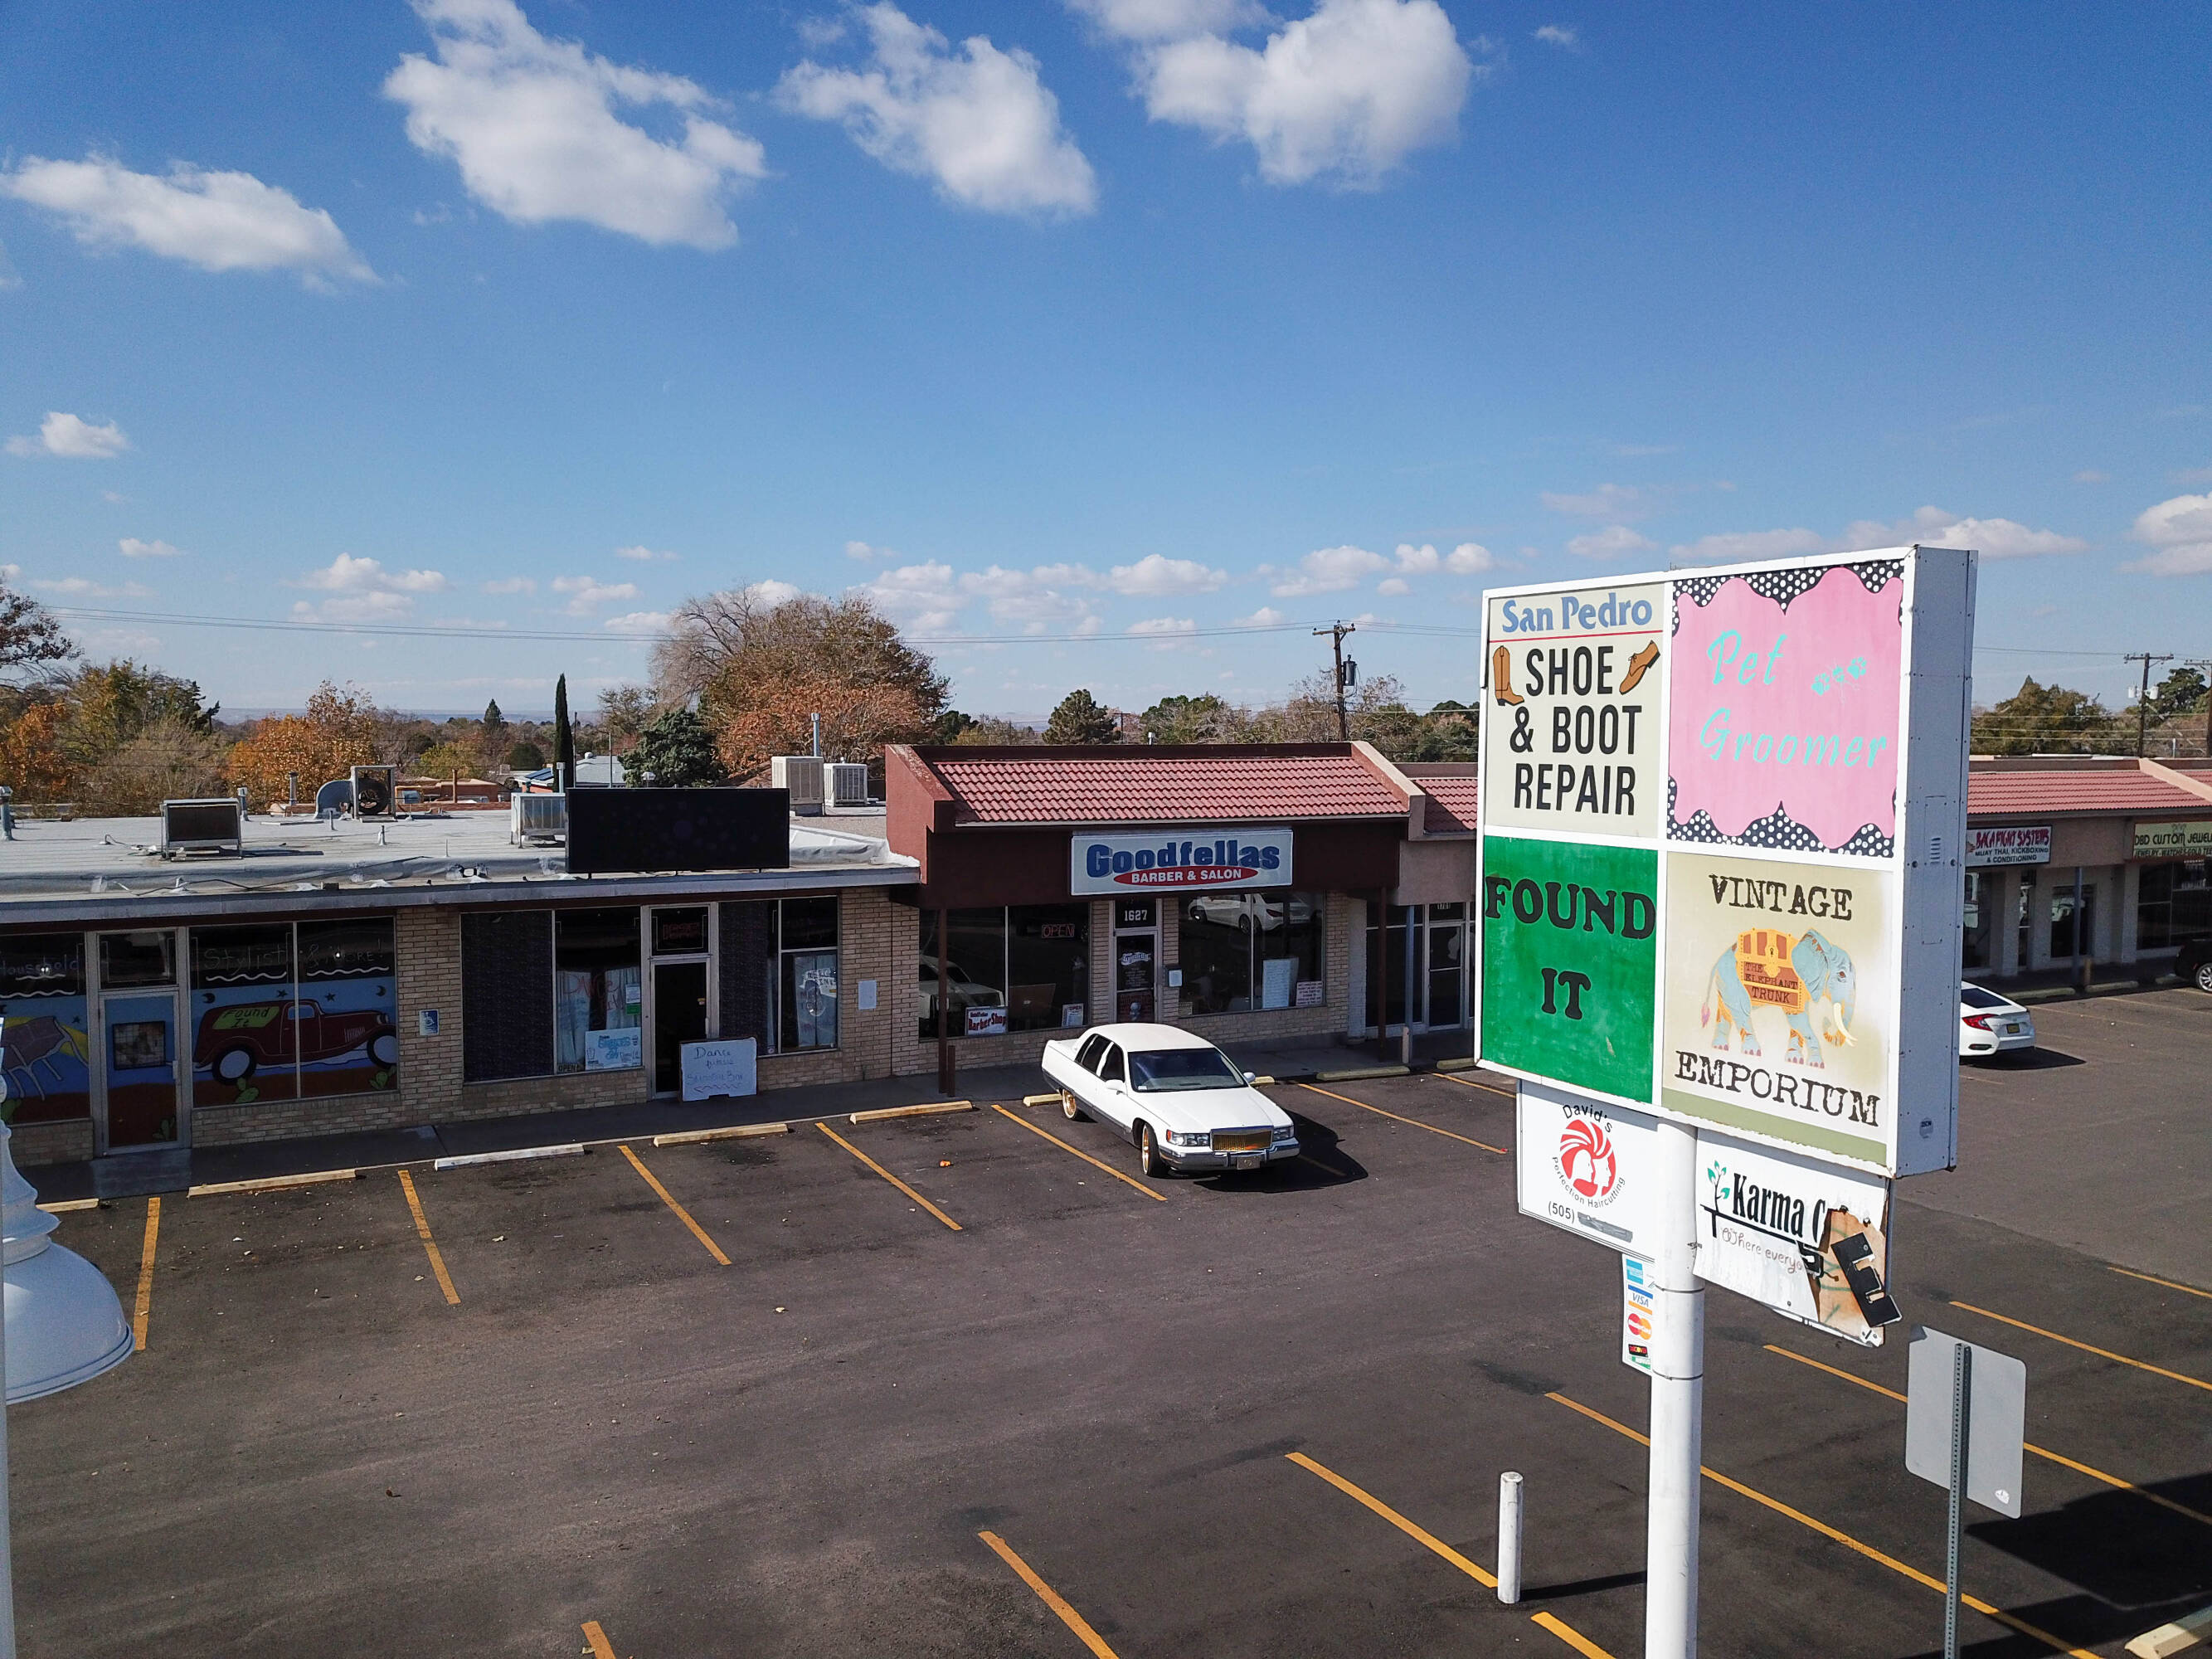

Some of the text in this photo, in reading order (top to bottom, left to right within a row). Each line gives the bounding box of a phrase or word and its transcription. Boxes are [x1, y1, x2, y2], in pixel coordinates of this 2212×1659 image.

[1502, 592, 1652, 633] San Pedro
[1526, 645, 1613, 696] SHOE
[1707, 630, 1787, 685] Pet
[1510, 704, 1642, 755] & BOOT
[1700, 707, 1887, 768] Groomer
[1514, 763, 1636, 815] REPAIR
[2188, 832, 2212, 844] JEWEL
[1087, 839, 1280, 878] Goodfellas
[1992, 854, 2037, 864] CONDITIONING
[1131, 868, 1242, 884] BARBER & SALON
[1485, 876, 1656, 940] FOUND
[1709, 873, 1852, 921] VINTAGE
[1124, 909, 1148, 922] 1627
[1043, 925, 1075, 937] OPEN
[1744, 973, 1798, 989] ELEPHANT
[1745, 961, 1763, 973] THE
[1541, 967, 1591, 1019] IT
[1752, 985, 1790, 1004] TRUNK
[223, 1006, 269, 1018] Found
[231, 1018, 250, 1027] It
[694, 1046, 731, 1059] Dance
[1675, 1050, 1880, 1126] EMPORIUM
[1563, 1105, 1612, 1133] David's
[1552, 1156, 1626, 1209] Perfection Haircutting
[1548, 1201, 1575, 1224] (505)
[1733, 1173, 1804, 1238] Karma
[1722, 1227, 1762, 1255] Where
[1632, 1292, 1649, 1307] VISA
